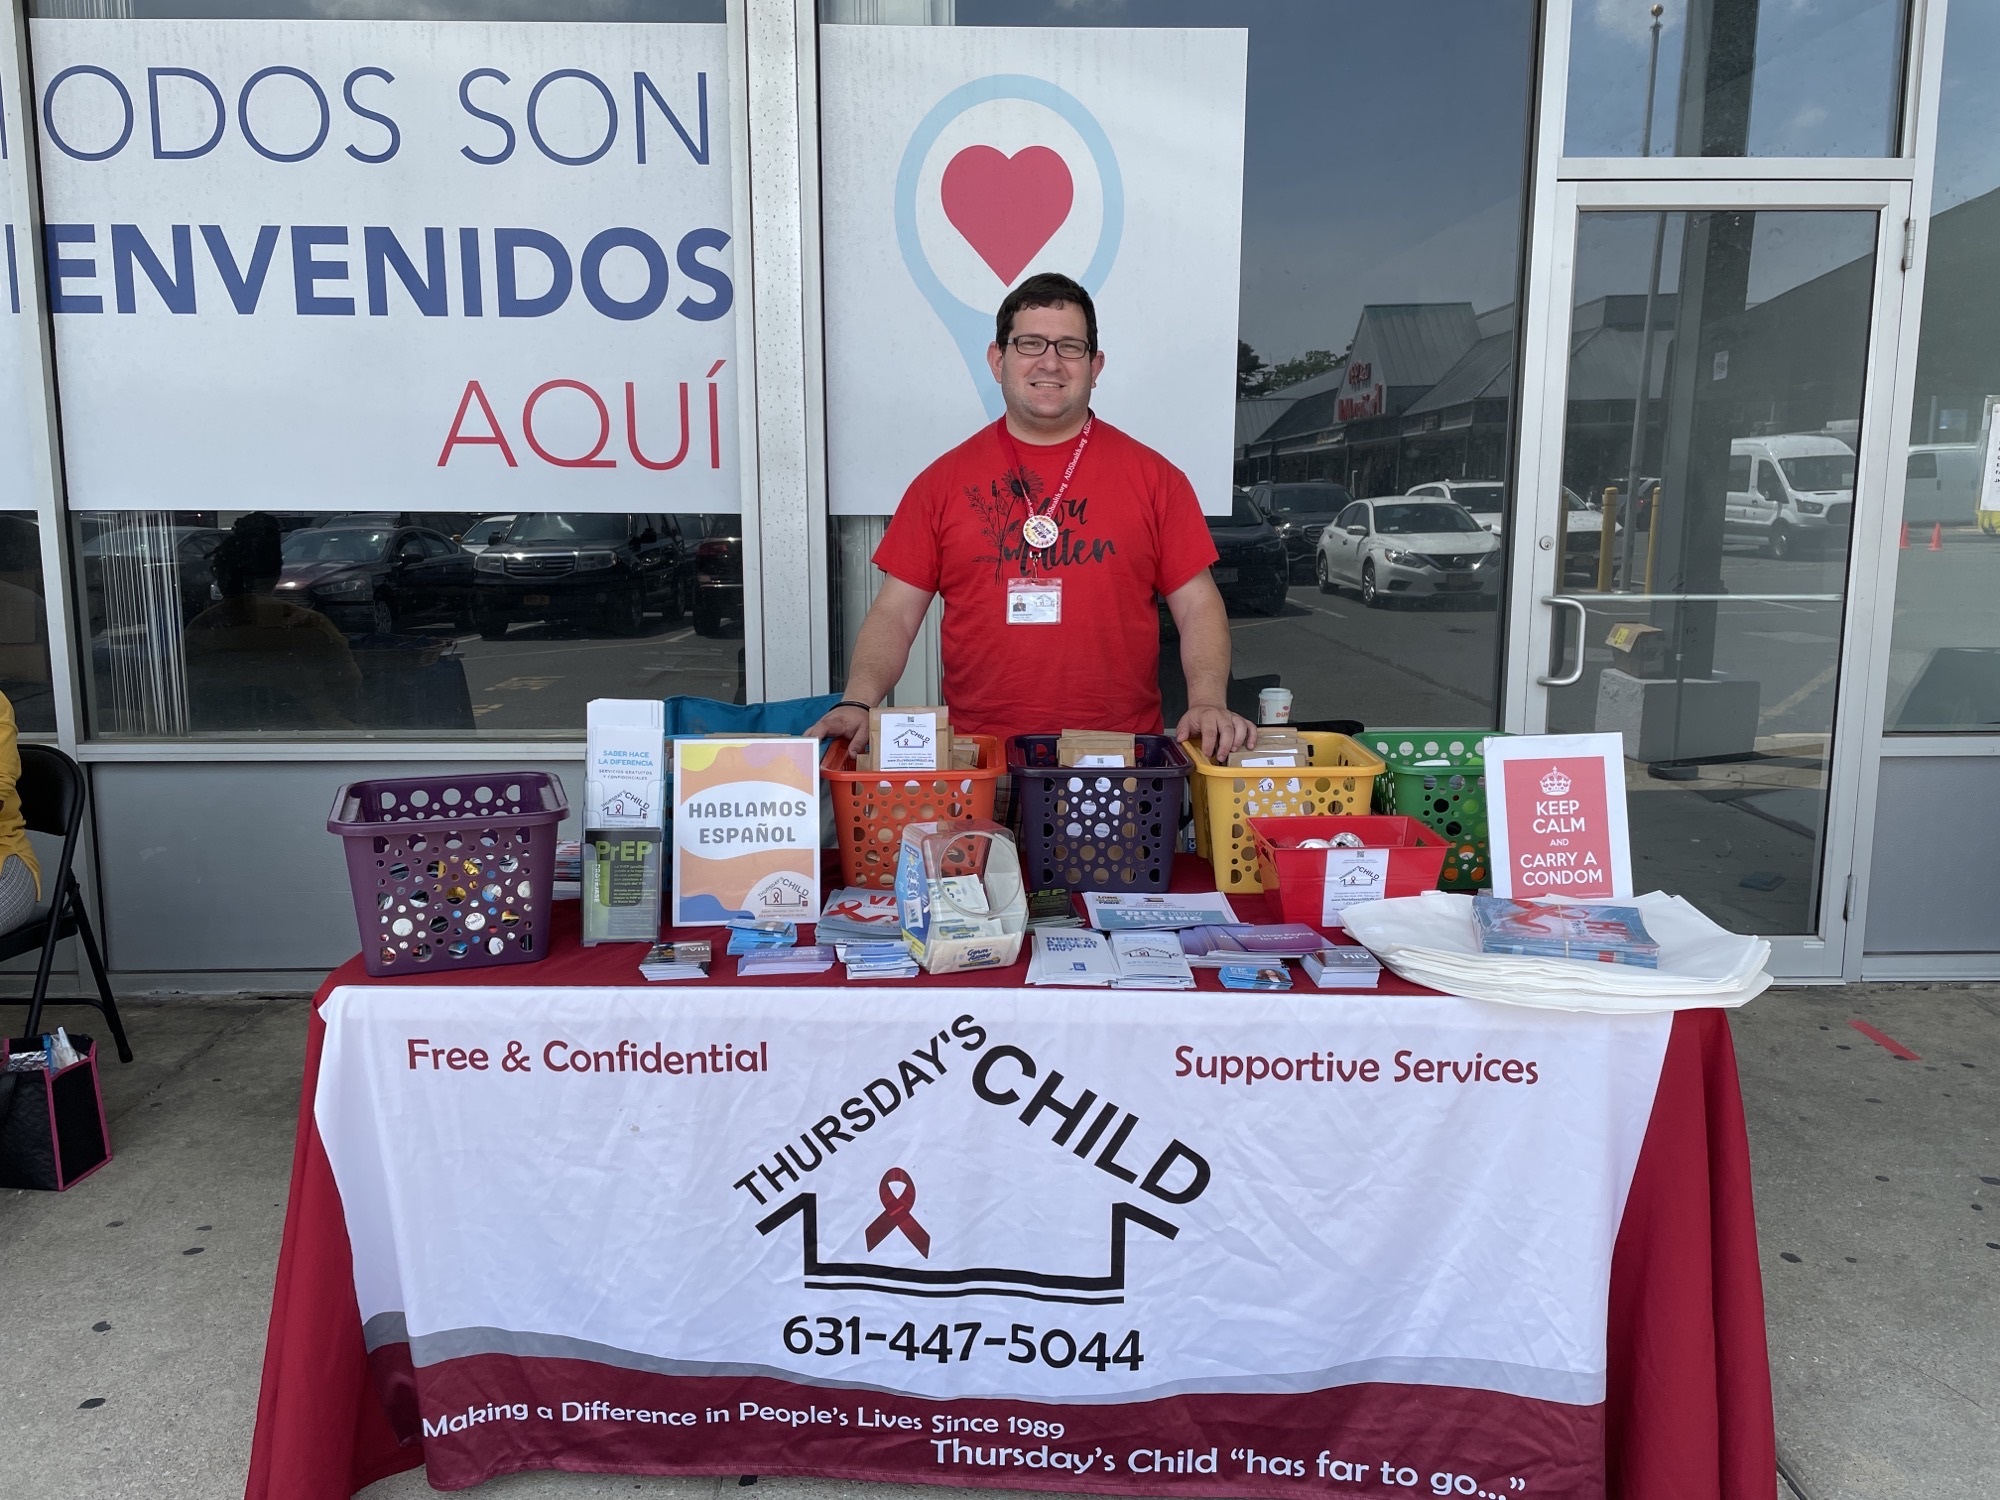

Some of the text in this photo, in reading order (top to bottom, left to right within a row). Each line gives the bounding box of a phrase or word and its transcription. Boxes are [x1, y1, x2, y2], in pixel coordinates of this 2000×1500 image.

[458, 67, 711, 166] SON
[437, 359, 727, 470] AQUÍ
[1045, 482, 1068, 519] DShealth.org
[910, 730, 931, 742] CHILD
[598, 758, 654, 767] LA DIFERENCIA
[603, 750, 650, 759] SABER HACE
[625, 792, 650, 810] CHILD
[688, 800, 807, 819] HABLAMOS
[1535, 800, 1580, 816] KEEP
[699, 823, 796, 845] ESPAÑOL
[1532, 817, 1586, 834] CALM
[595, 840, 653, 862] PrEP
[1549, 838, 1570, 847] AND
[1520, 851, 1598, 868] CARRY A
[1358, 866, 1380, 880] CHILD
[1522, 868, 1603, 886] CONDOM
[782, 878, 810, 897] CHILD
[1026, 887, 1067, 897] rEP
[408, 1039, 769, 1075] Free & Confidential
[1175, 1045, 1539, 1084] Supportive Services
[732, 1013, 1212, 1206] THURSDAY'S CHILD
[783, 1315, 1145, 1371] 631-447-5044
[422, 1400, 1065, 1439] Making a Difference in People's Lives Since 1989
[930, 1438, 1116, 1475] Thursday's
[1128, 1447, 1218, 1474] Child
[1316, 1450, 1370, 1483] far
[1380, 1461, 1419, 1487] to
